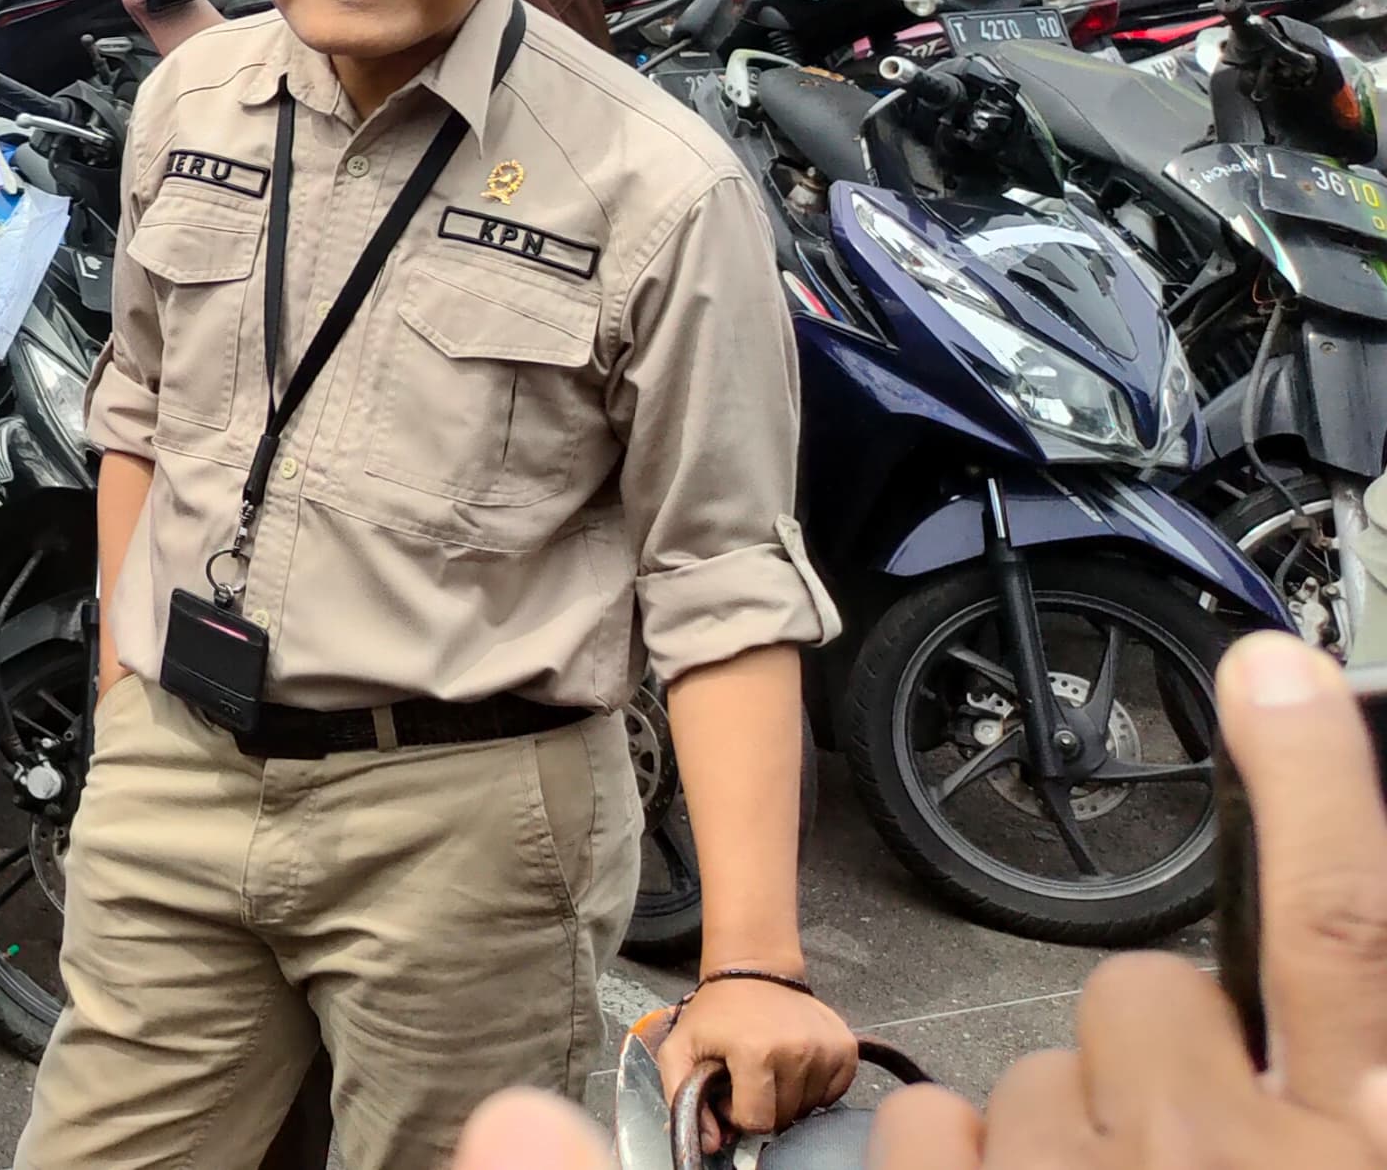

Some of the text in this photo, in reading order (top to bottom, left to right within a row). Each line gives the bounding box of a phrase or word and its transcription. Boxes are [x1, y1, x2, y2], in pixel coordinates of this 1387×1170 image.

[954, 22, 967, 42] T
[980, 18, 1022, 41] 4270
[1266, 153, 1380, 208] L 3610
[479, 219, 545, 257] KPN
